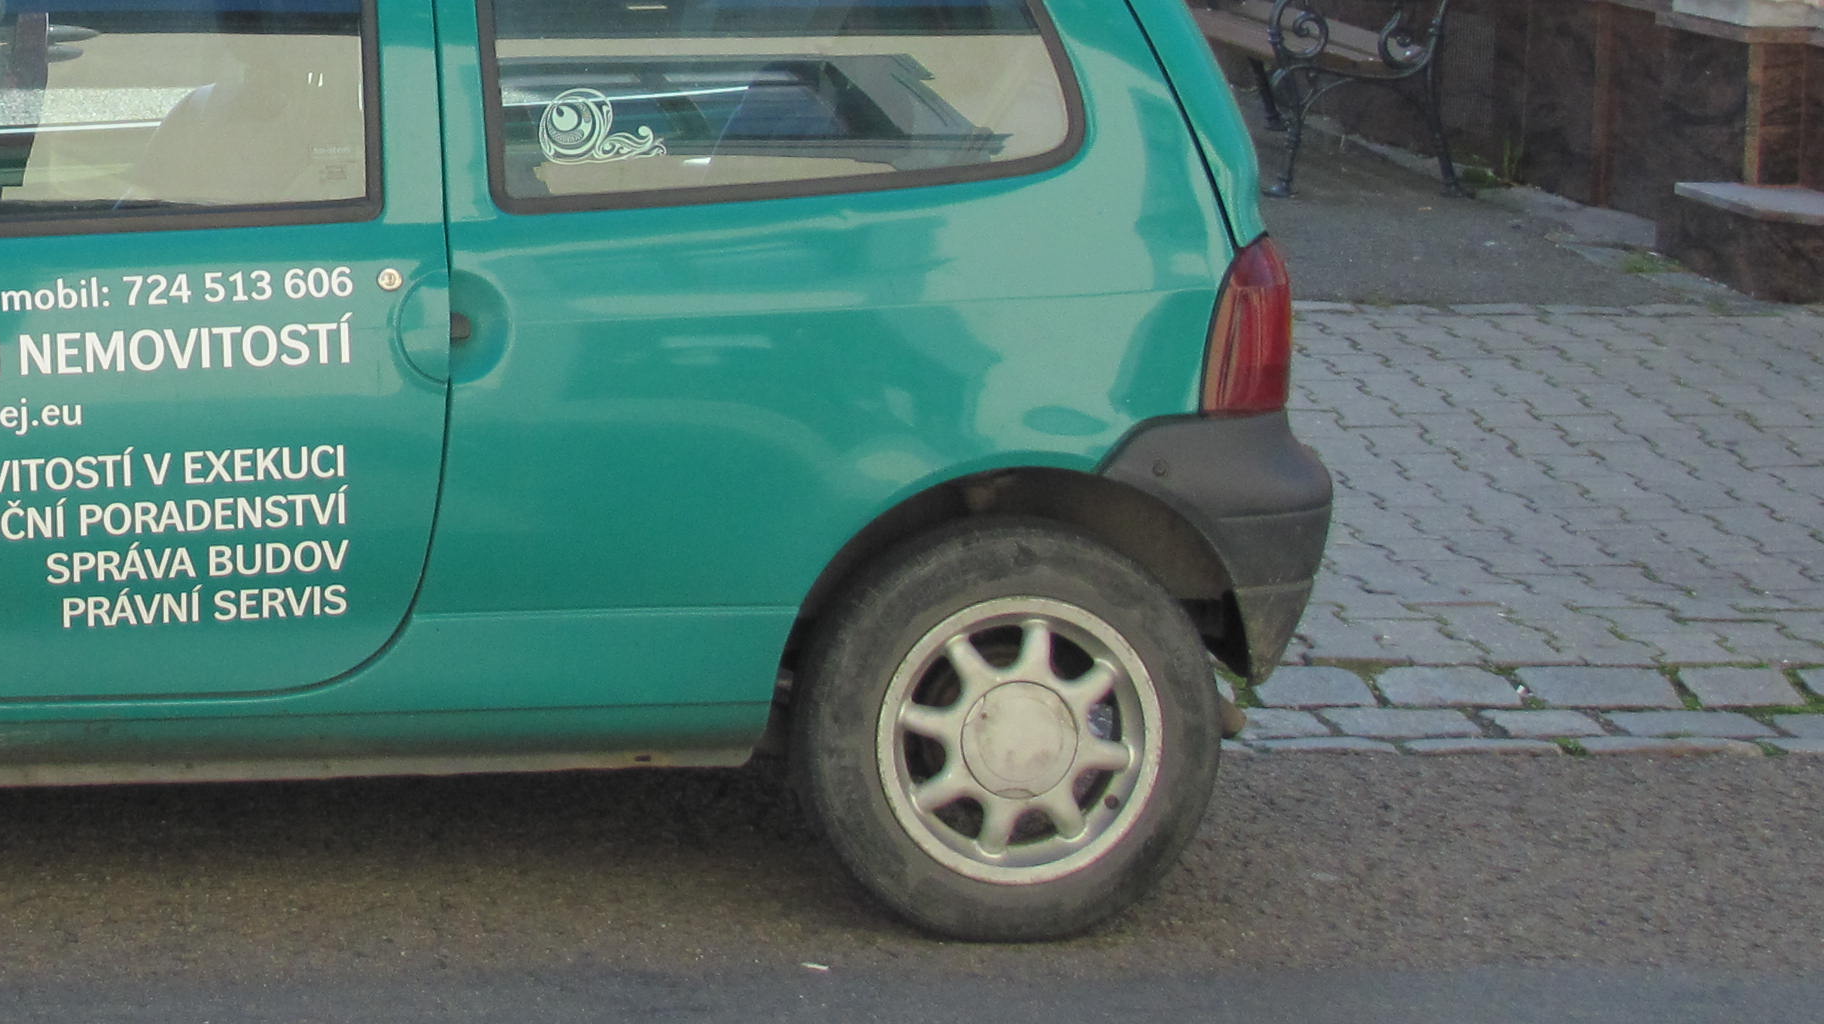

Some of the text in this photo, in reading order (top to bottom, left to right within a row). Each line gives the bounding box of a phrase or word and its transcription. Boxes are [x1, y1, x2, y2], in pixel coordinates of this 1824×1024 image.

[0, 266, 353, 312] mobil: 724 513 606
[19, 312, 353, 376] NEMOVITOSTÍ
[143, 452, 172, 485] V
[184, 444, 345, 484] EXEKUCI
[79, 484, 349, 537] PORADENSTVÍ
[46, 539, 349, 584] SPRÁVA BUDOV
[62, 584, 348, 628] PRÁVNÍ SERVIS
